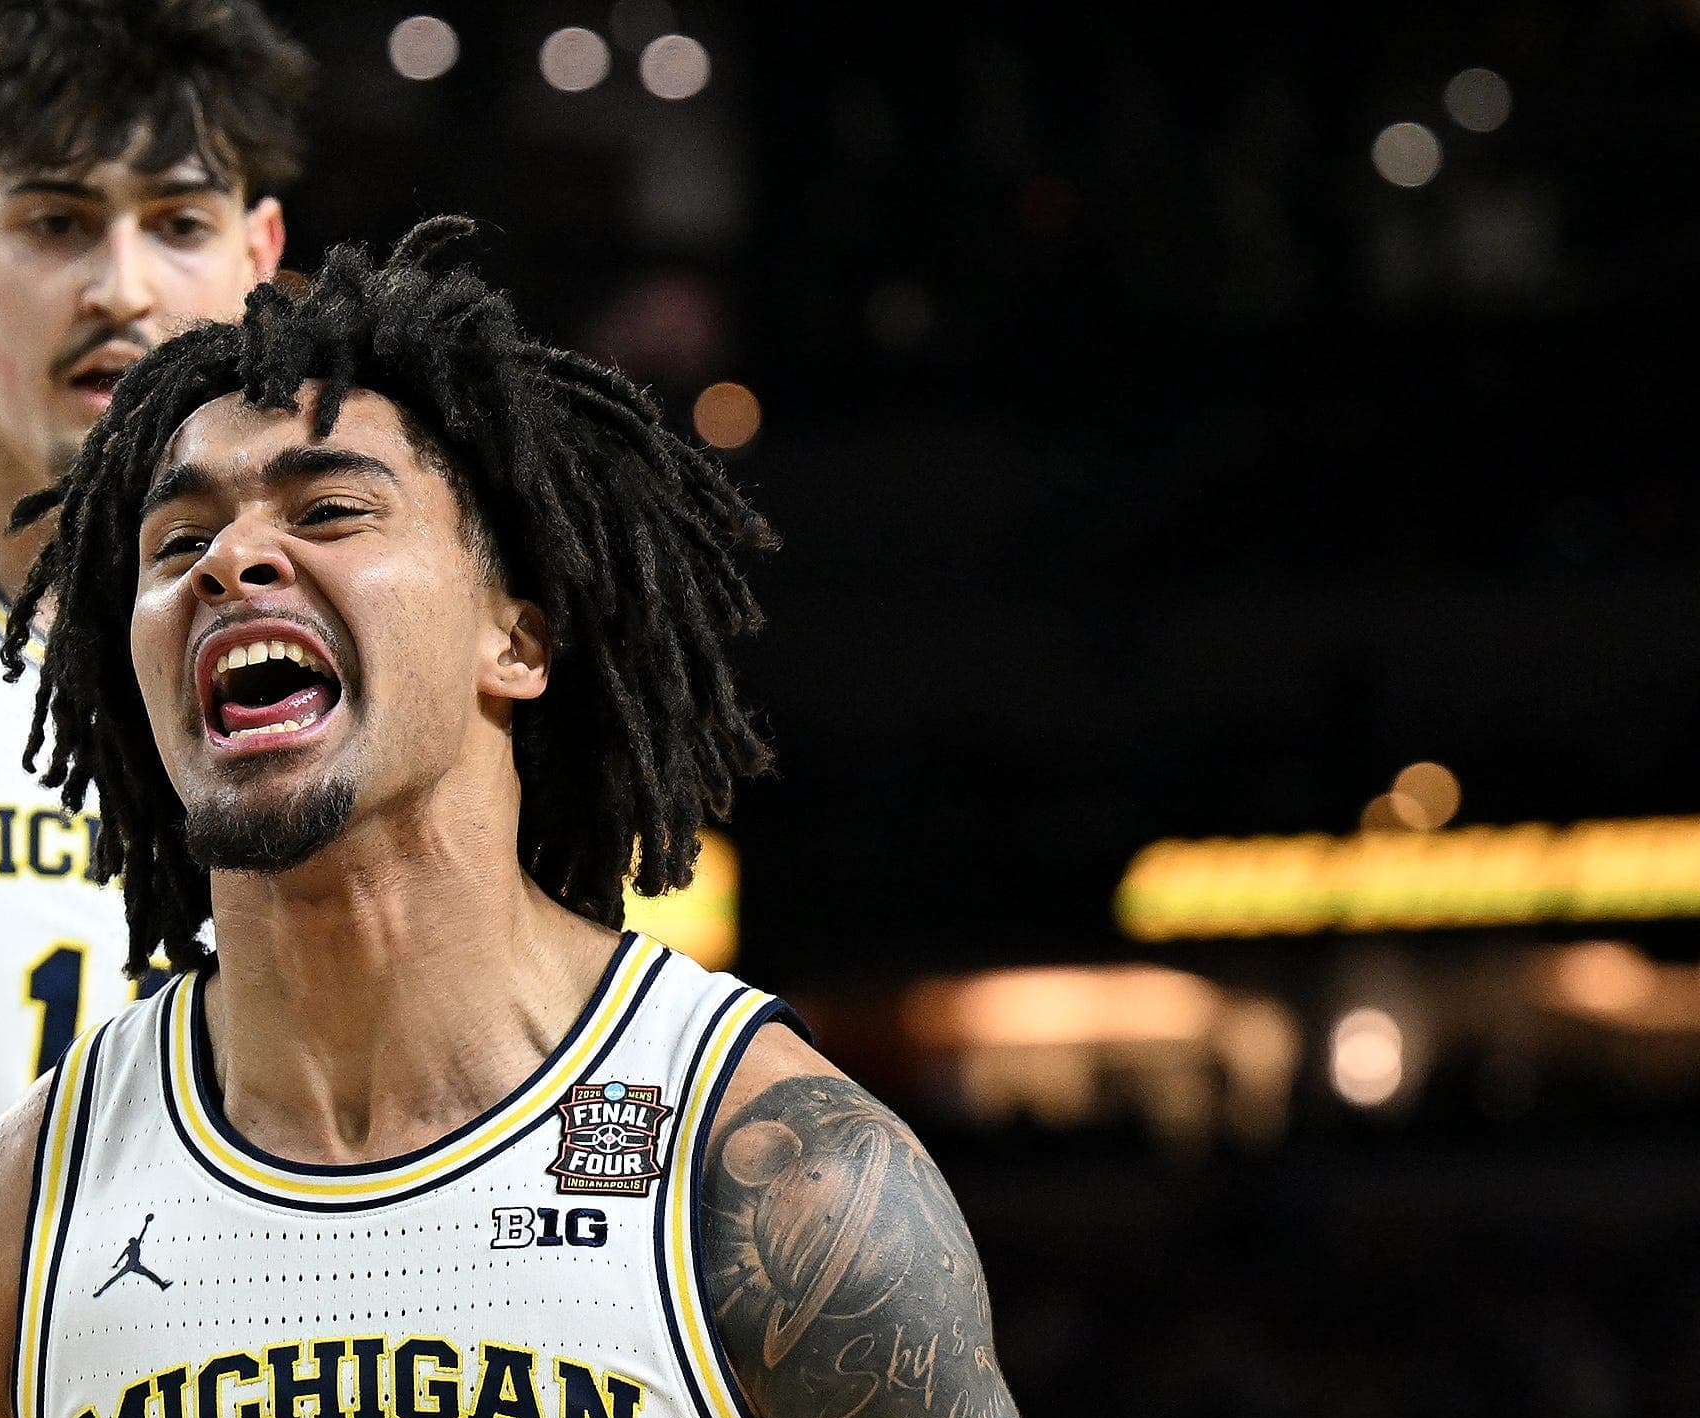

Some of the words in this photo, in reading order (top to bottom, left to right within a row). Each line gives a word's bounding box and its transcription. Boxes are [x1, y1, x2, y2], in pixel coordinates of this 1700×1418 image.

[628, 1091, 652, 1101] MEN'S
[573, 1103, 648, 1128] FINAL
[568, 1151, 643, 1175] FOUR
[567, 1177, 641, 1189] INDIANAPOLIS
